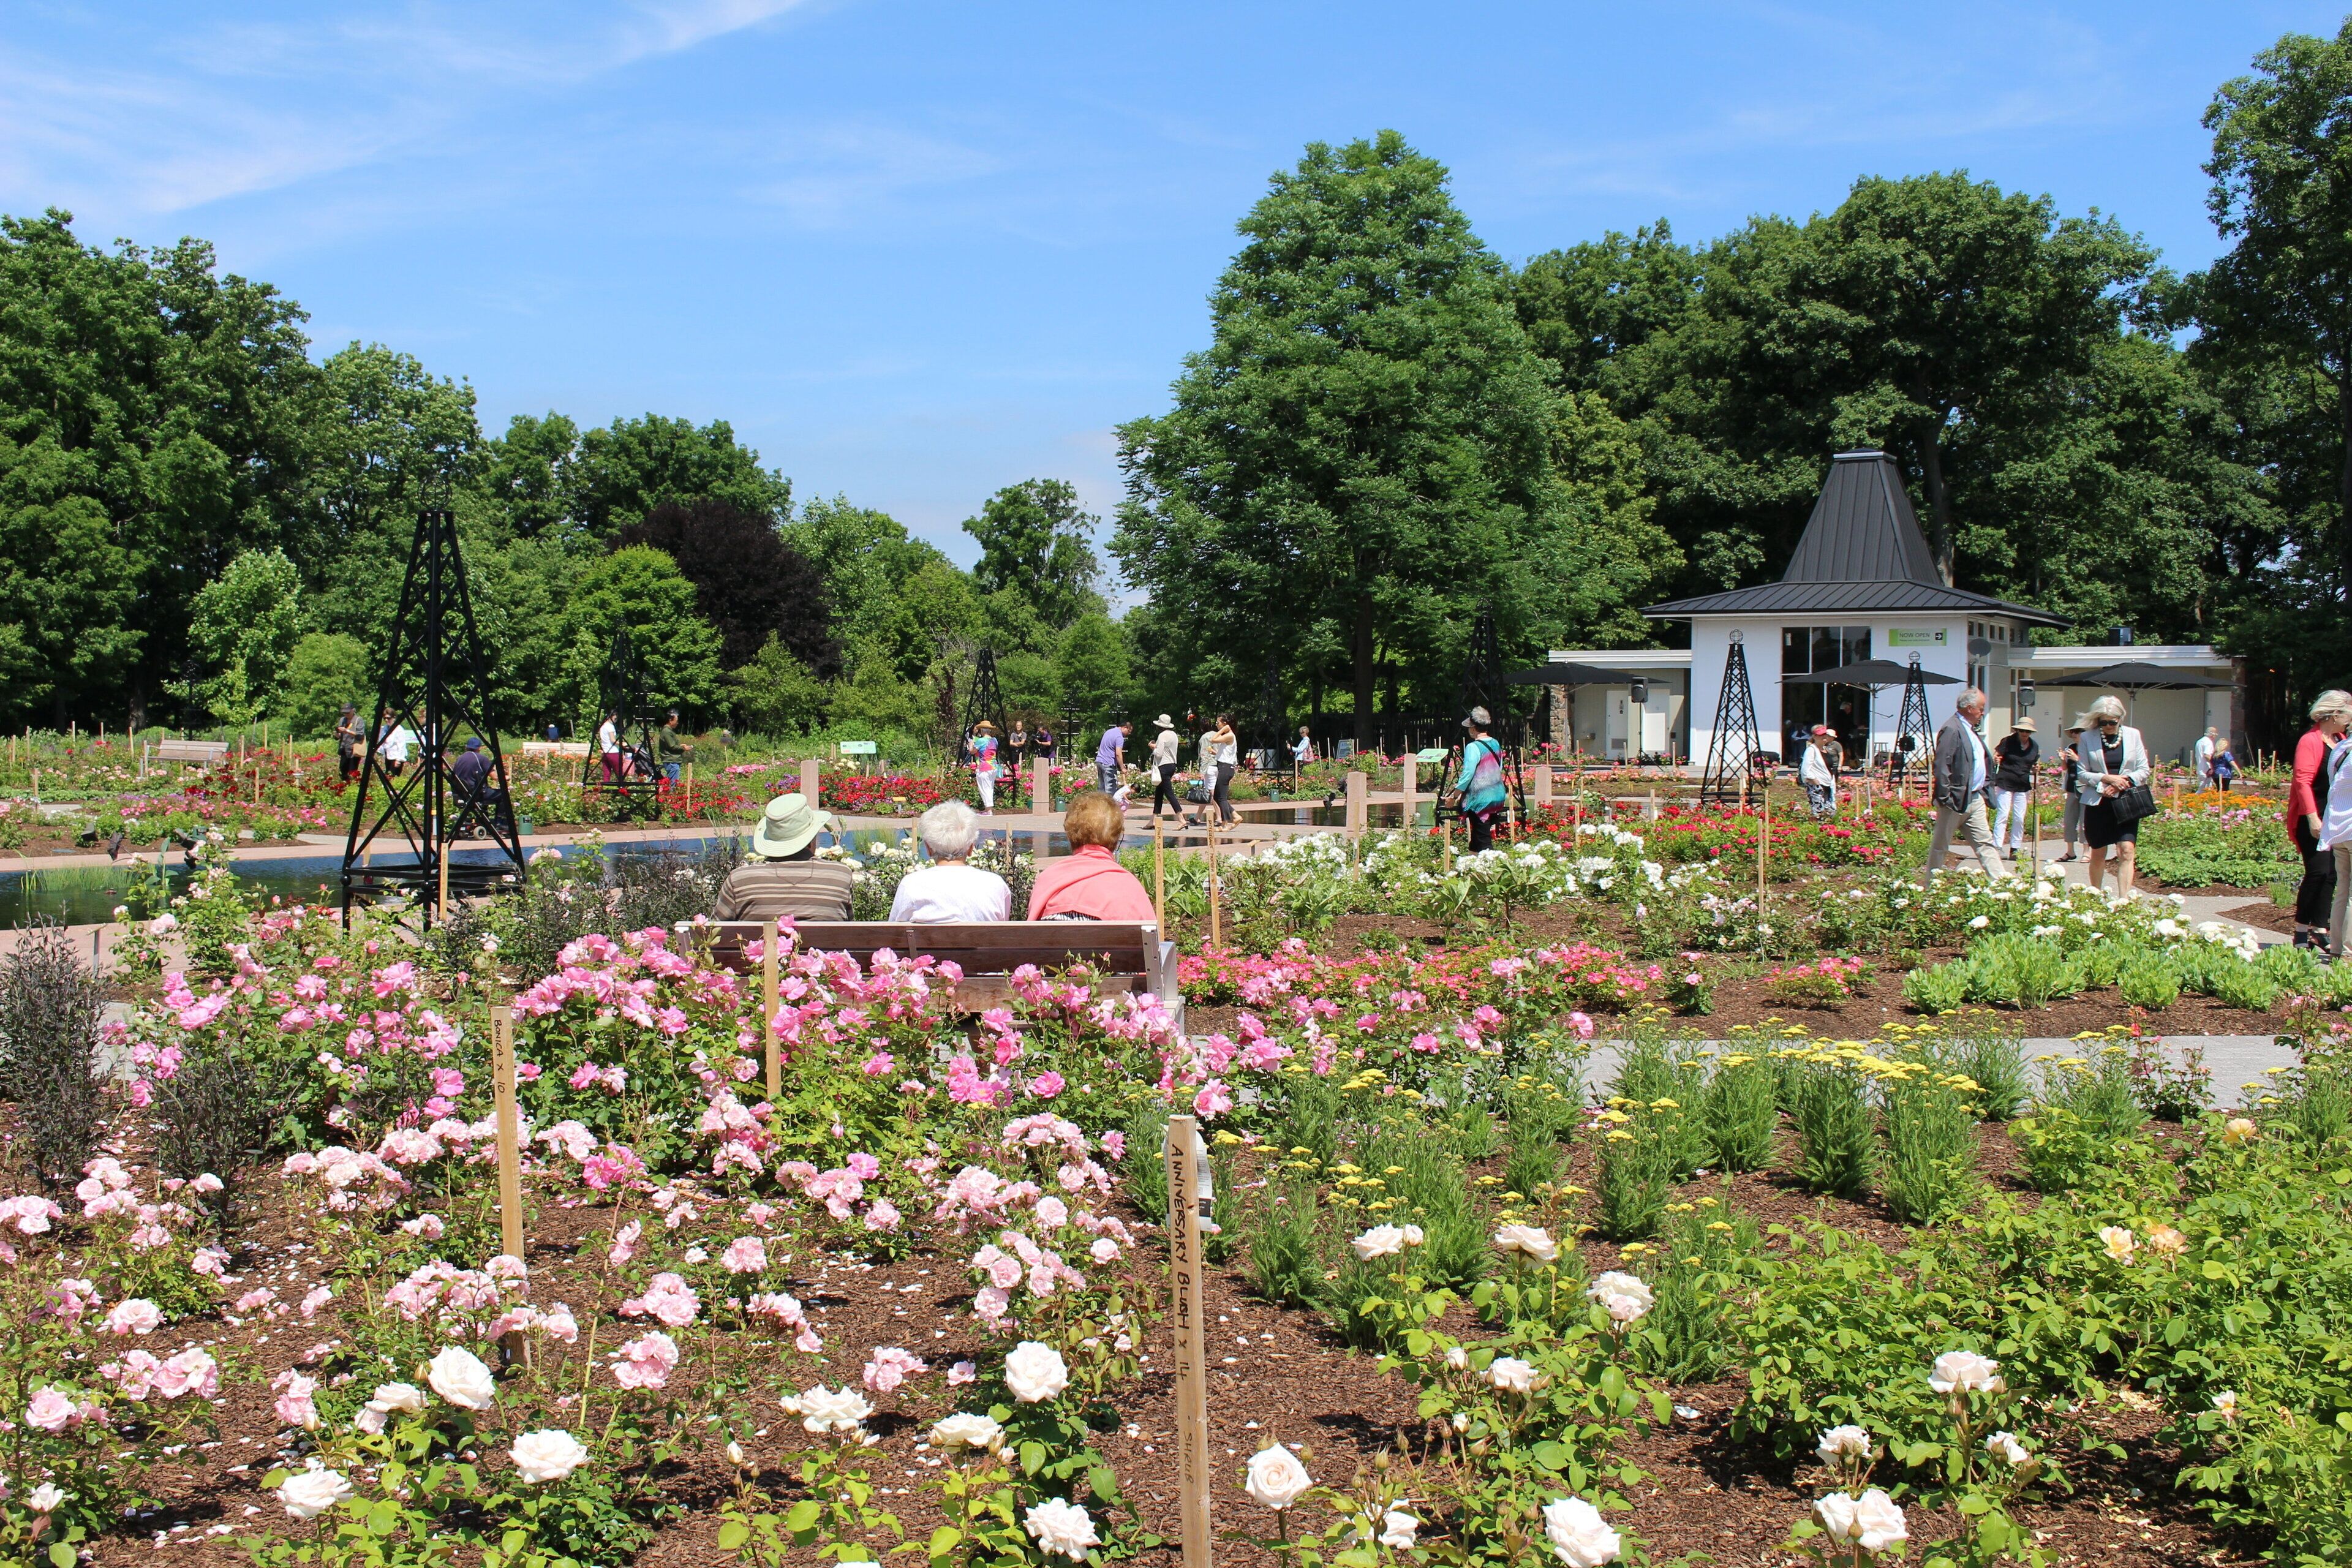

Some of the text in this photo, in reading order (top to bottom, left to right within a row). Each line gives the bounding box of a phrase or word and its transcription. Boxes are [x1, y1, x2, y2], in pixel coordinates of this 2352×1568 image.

[494, 1019, 503, 1057] BONICA
[497, 1082, 505, 1093] 10
[1172, 1144, 1188, 1264] ANNIVERSARY
[1177, 1273, 1190, 1329] BLUSH
[1177, 1362, 1190, 1381] 14
[1183, 1430, 1194, 1484] SHRUB
